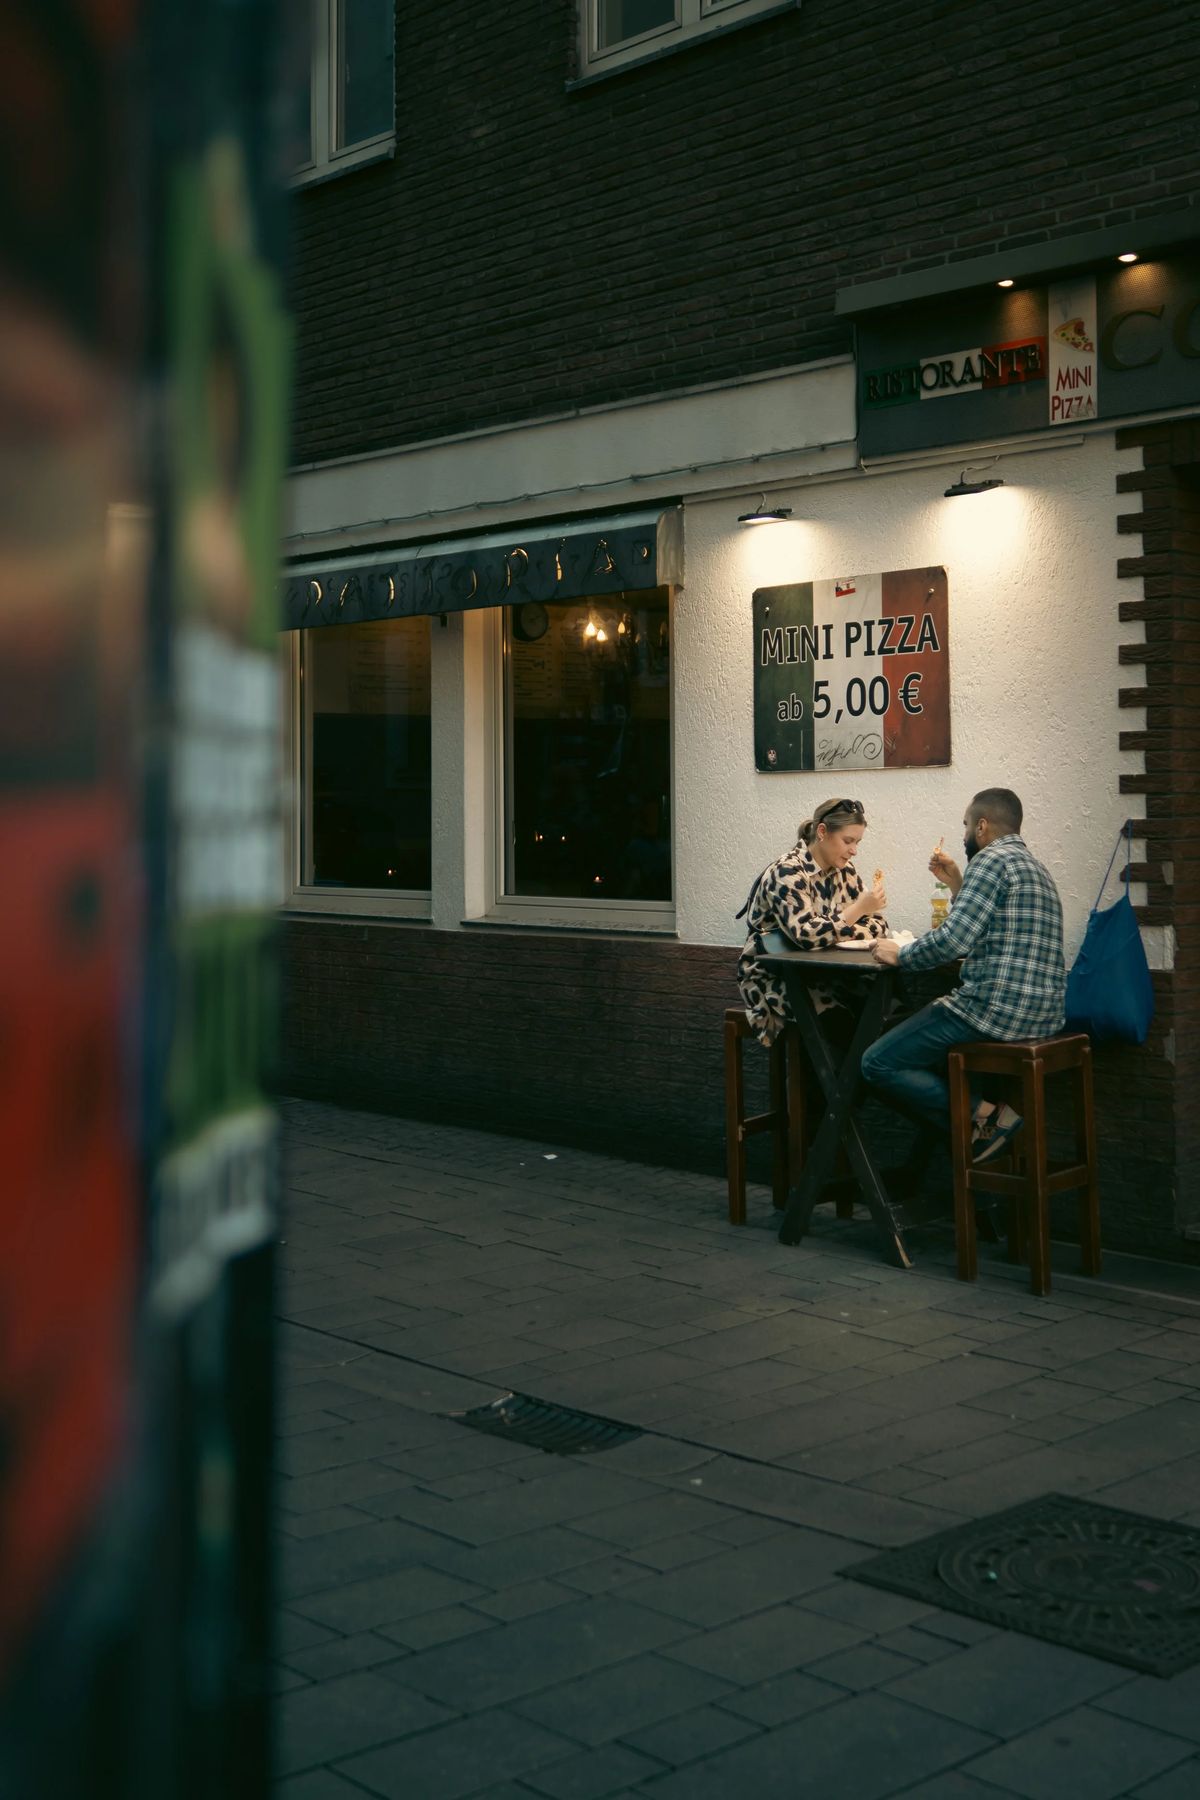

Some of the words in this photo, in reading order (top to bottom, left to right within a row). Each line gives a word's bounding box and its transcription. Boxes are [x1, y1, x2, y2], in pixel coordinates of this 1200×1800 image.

[865, 343, 1042, 402] RISTORANTE
[1056, 365, 1092, 392] MINI
[1051, 394, 1096, 422] PIZZA
[760, 622, 834, 665] MINI
[845, 613, 940, 658] PIZZA
[777, 693, 803, 722] ab
[812, 674, 890, 724] 5,00
[898, 671, 924, 715] €
